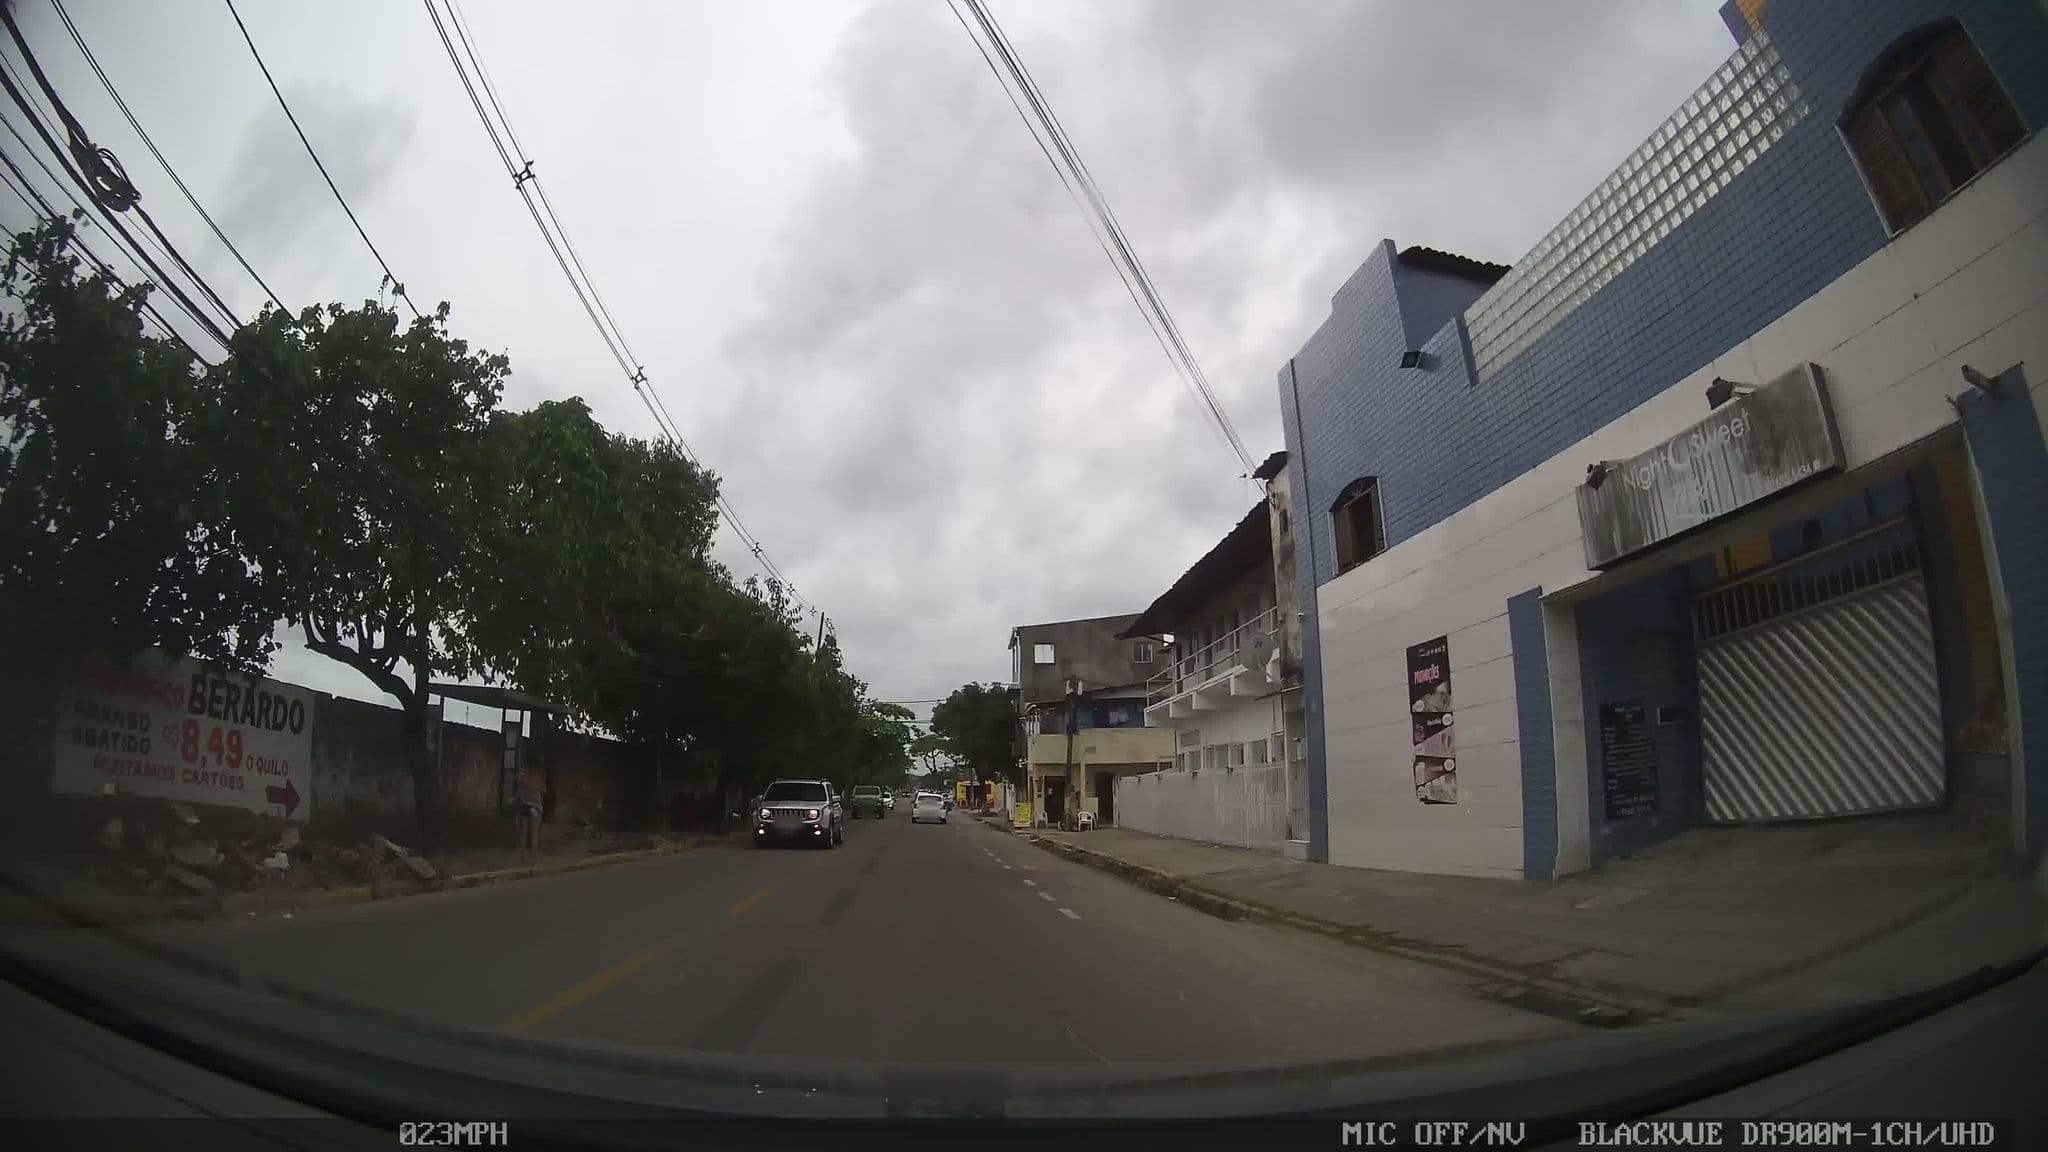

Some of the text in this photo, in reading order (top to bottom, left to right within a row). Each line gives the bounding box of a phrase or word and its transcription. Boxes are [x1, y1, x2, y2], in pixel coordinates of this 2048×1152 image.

[188, 673, 305, 735] BERARDO
[180, 718, 244, 770] 8,49
[256, 757, 290, 777] QUILO
